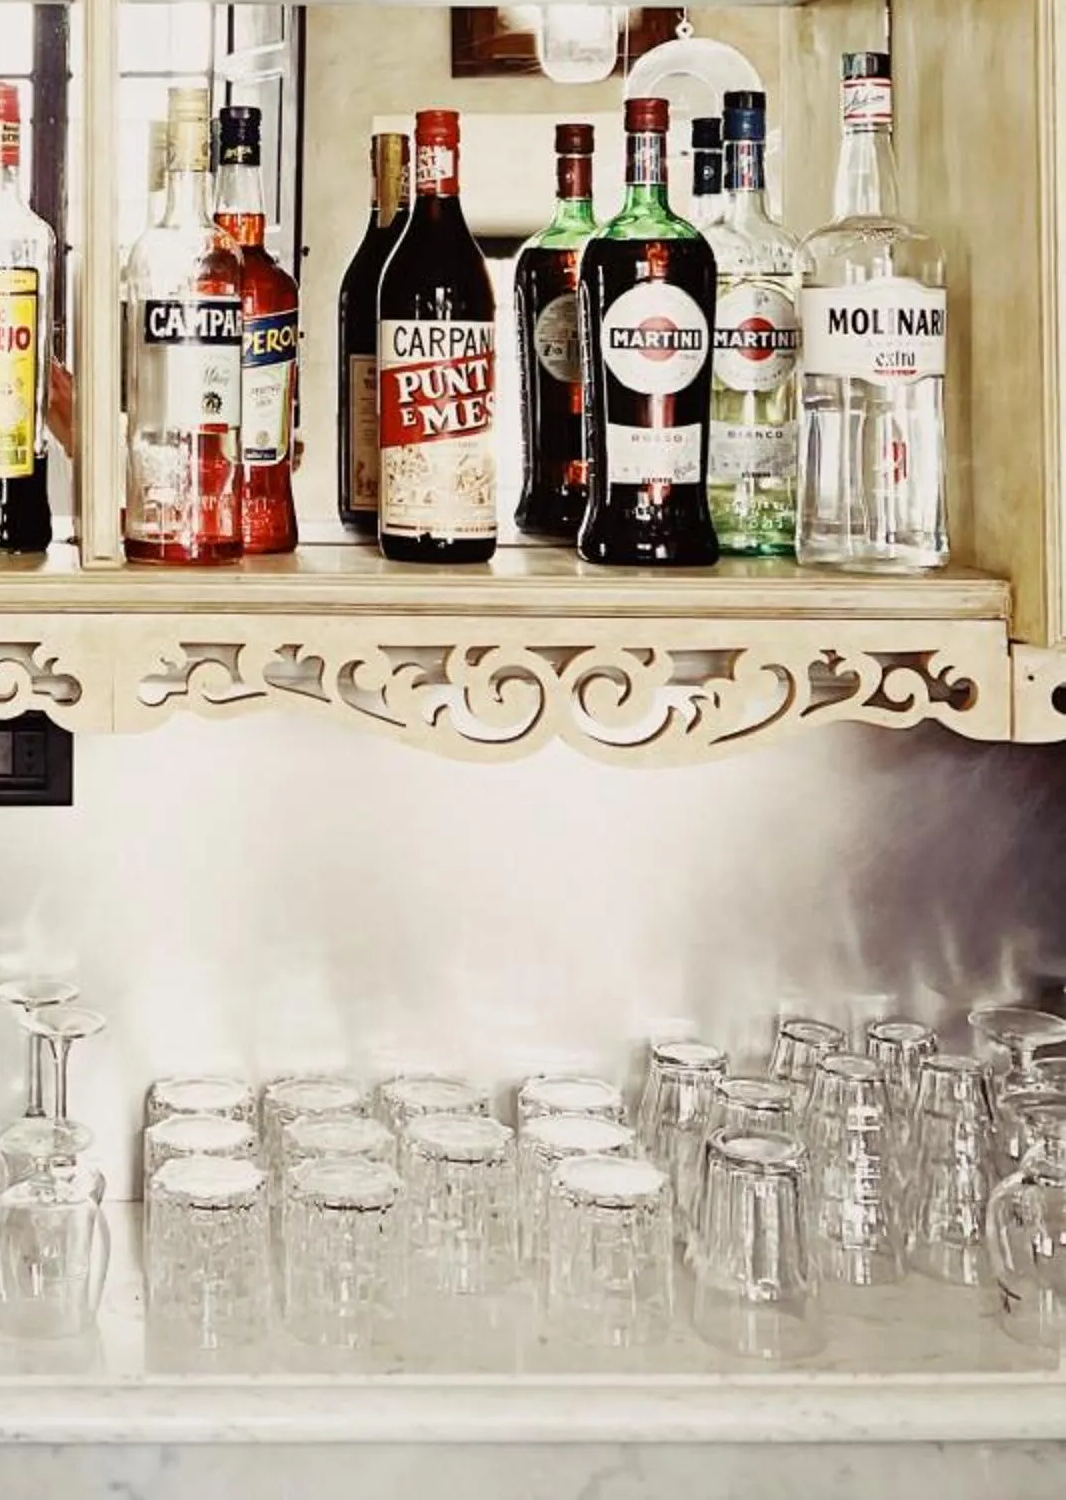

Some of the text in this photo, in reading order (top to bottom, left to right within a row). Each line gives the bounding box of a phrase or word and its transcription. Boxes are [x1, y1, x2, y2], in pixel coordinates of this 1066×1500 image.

[393, 325, 493, 357] CARPAN
[613, 329, 699, 348] MARTINI
[714, 331, 795, 349] MARTINI
[395, 357, 489, 405] PUNT
[401, 407, 417, 427] E
